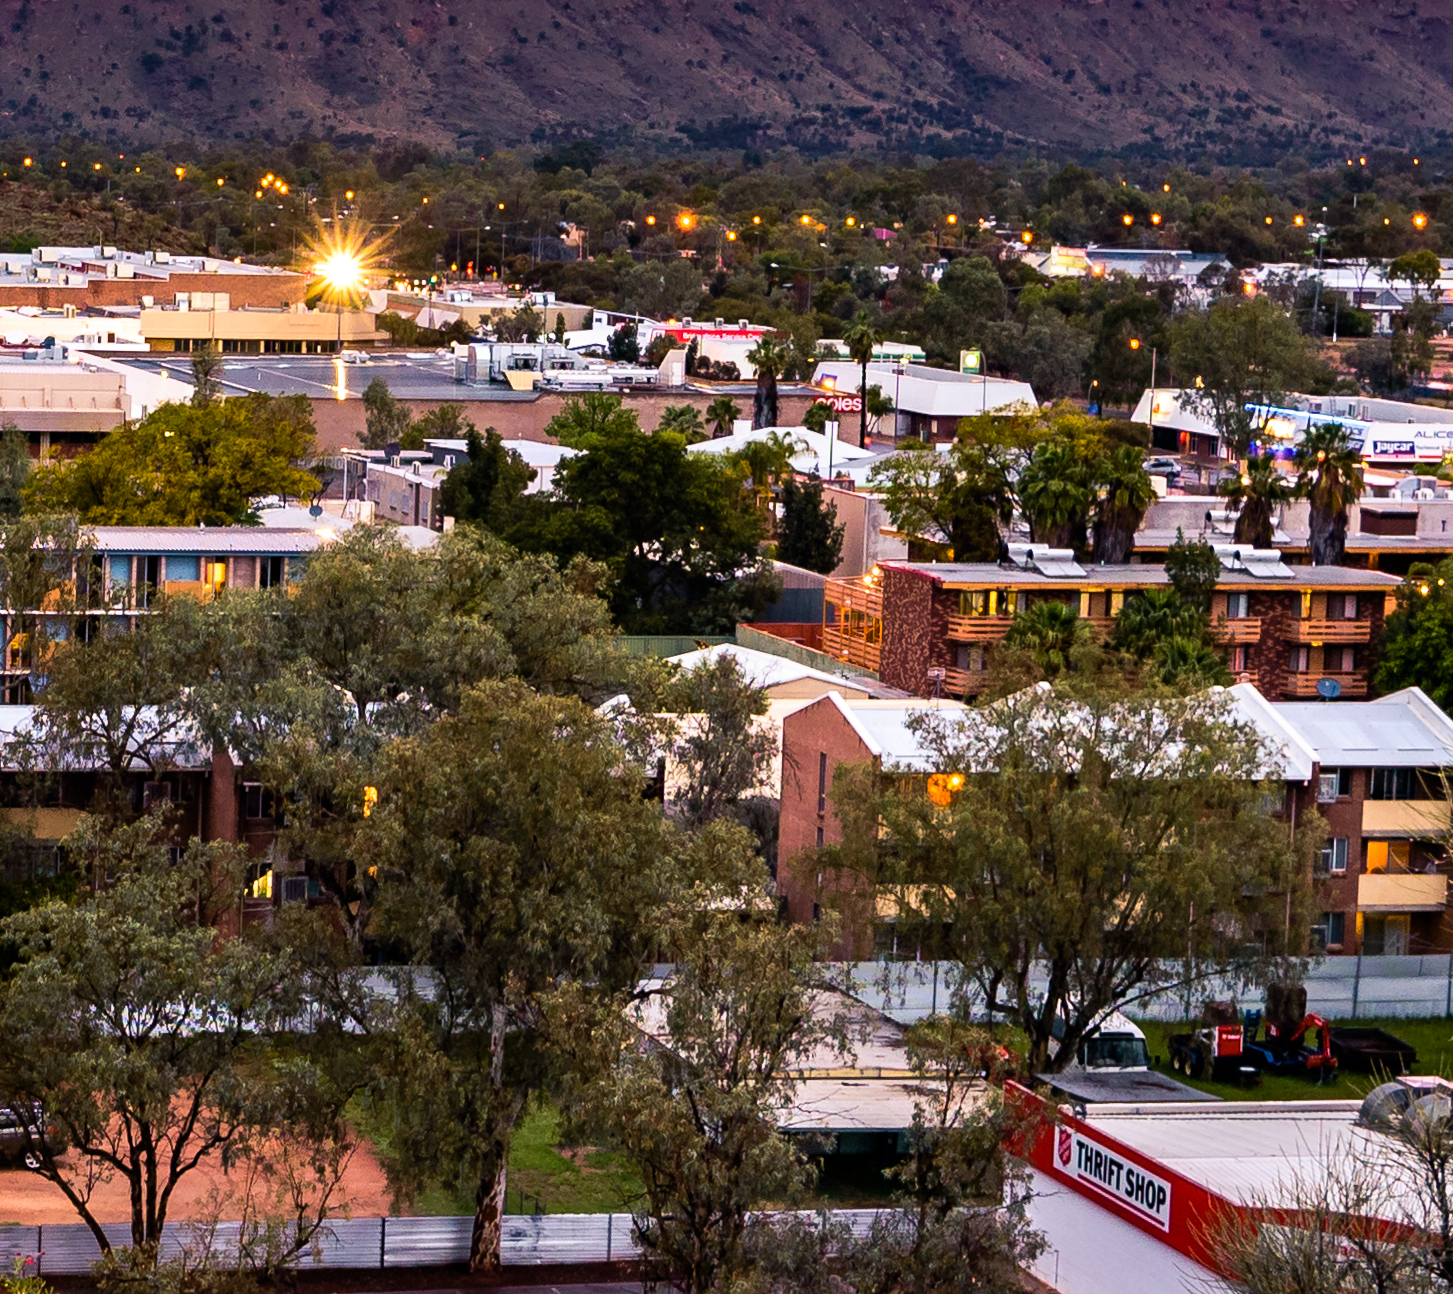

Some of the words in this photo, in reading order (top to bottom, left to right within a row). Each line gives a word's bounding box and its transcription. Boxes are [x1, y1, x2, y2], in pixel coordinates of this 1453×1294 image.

[1374, 441, 1413, 454] Jaycar
[1076, 1138, 1124, 1191] THRIFT
[1124, 1168, 1167, 1214] SHOP
